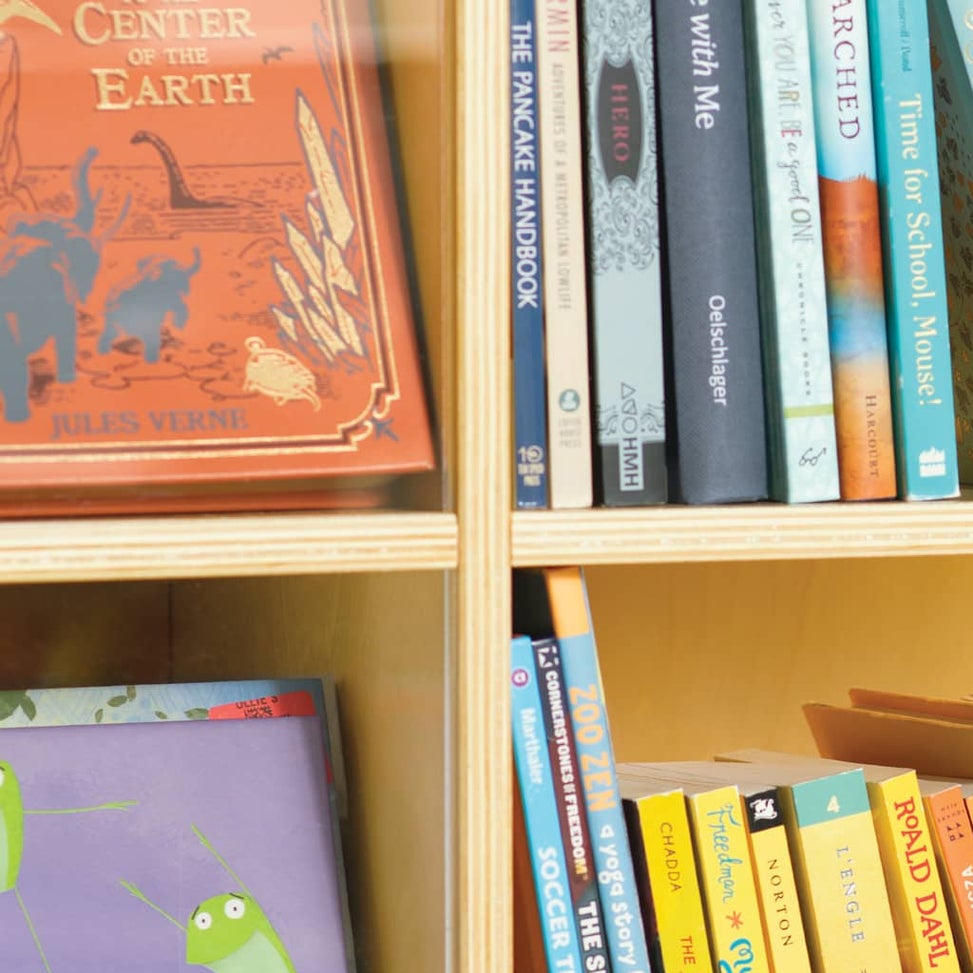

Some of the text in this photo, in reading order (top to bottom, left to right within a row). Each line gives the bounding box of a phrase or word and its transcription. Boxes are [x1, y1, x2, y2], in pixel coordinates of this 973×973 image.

[73, 2, 256, 45] CENTER
[128, 47, 208, 65] OF THE
[547, 0, 570, 52] MIN
[690, 13, 719, 76] with
[91, 68, 255, 110] EARTH
[553, 64, 567, 136] ADVENTURES
[694, 85, 720, 129] Me
[611, 84, 630, 162] HERO
[900, 93, 922, 160] Time
[511, 21, 538, 308] THE PANCAKE HANDBOOK
[904, 168, 928, 204] for
[555, 173, 570, 257] METROPOLITAN
[709, 295, 729, 406] Oelschlager
[913, 315, 943, 406] Mouse!
[50, 407, 249, 440] JULES VERNE
[866, 395, 880, 477] HARCOURT
[623, 437, 640, 487] HMH
[545, 670, 574, 783] CORNERSTONES
[569, 683, 617, 812] ZOO ZEN
[600, 823, 615, 838] a
[826, 795, 841, 813] 4
[598, 844, 625, 897] yoga
[659, 822, 683, 893] CHADDA
[706, 803, 743, 905] Freedman
[894, 796, 950, 968] ROALD DAHL
[538, 847, 571, 950] SOCCER
[578, 901, 603, 951] THE
[767, 857, 794, 946] NORTON
[836, 847, 866, 943] L'ENGLE
[611, 902, 637, 966] story
[680, 935, 697, 966] THE
